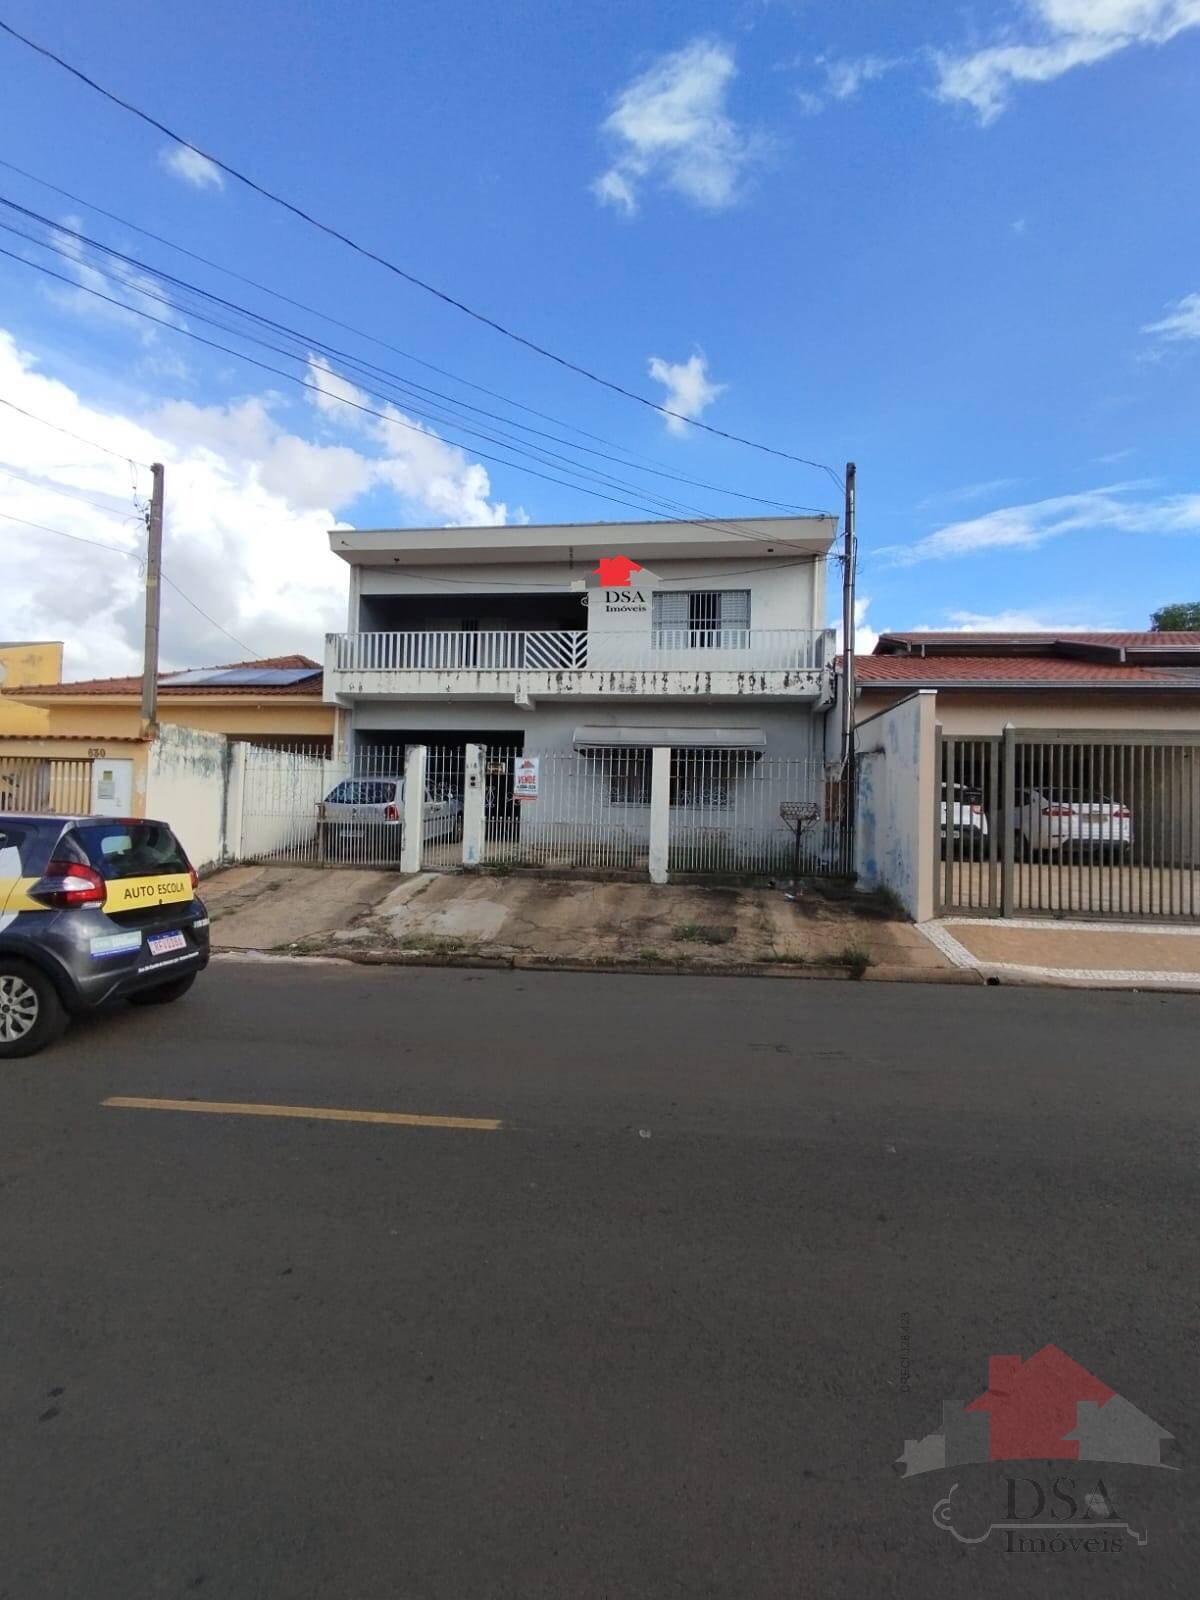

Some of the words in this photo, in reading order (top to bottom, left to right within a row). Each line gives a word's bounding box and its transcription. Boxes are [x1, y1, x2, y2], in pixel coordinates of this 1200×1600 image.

[518, 775, 536, 784] VENDE
[124, 886, 154, 899] AUTO
[158, 883, 184, 895] ESCOLA
